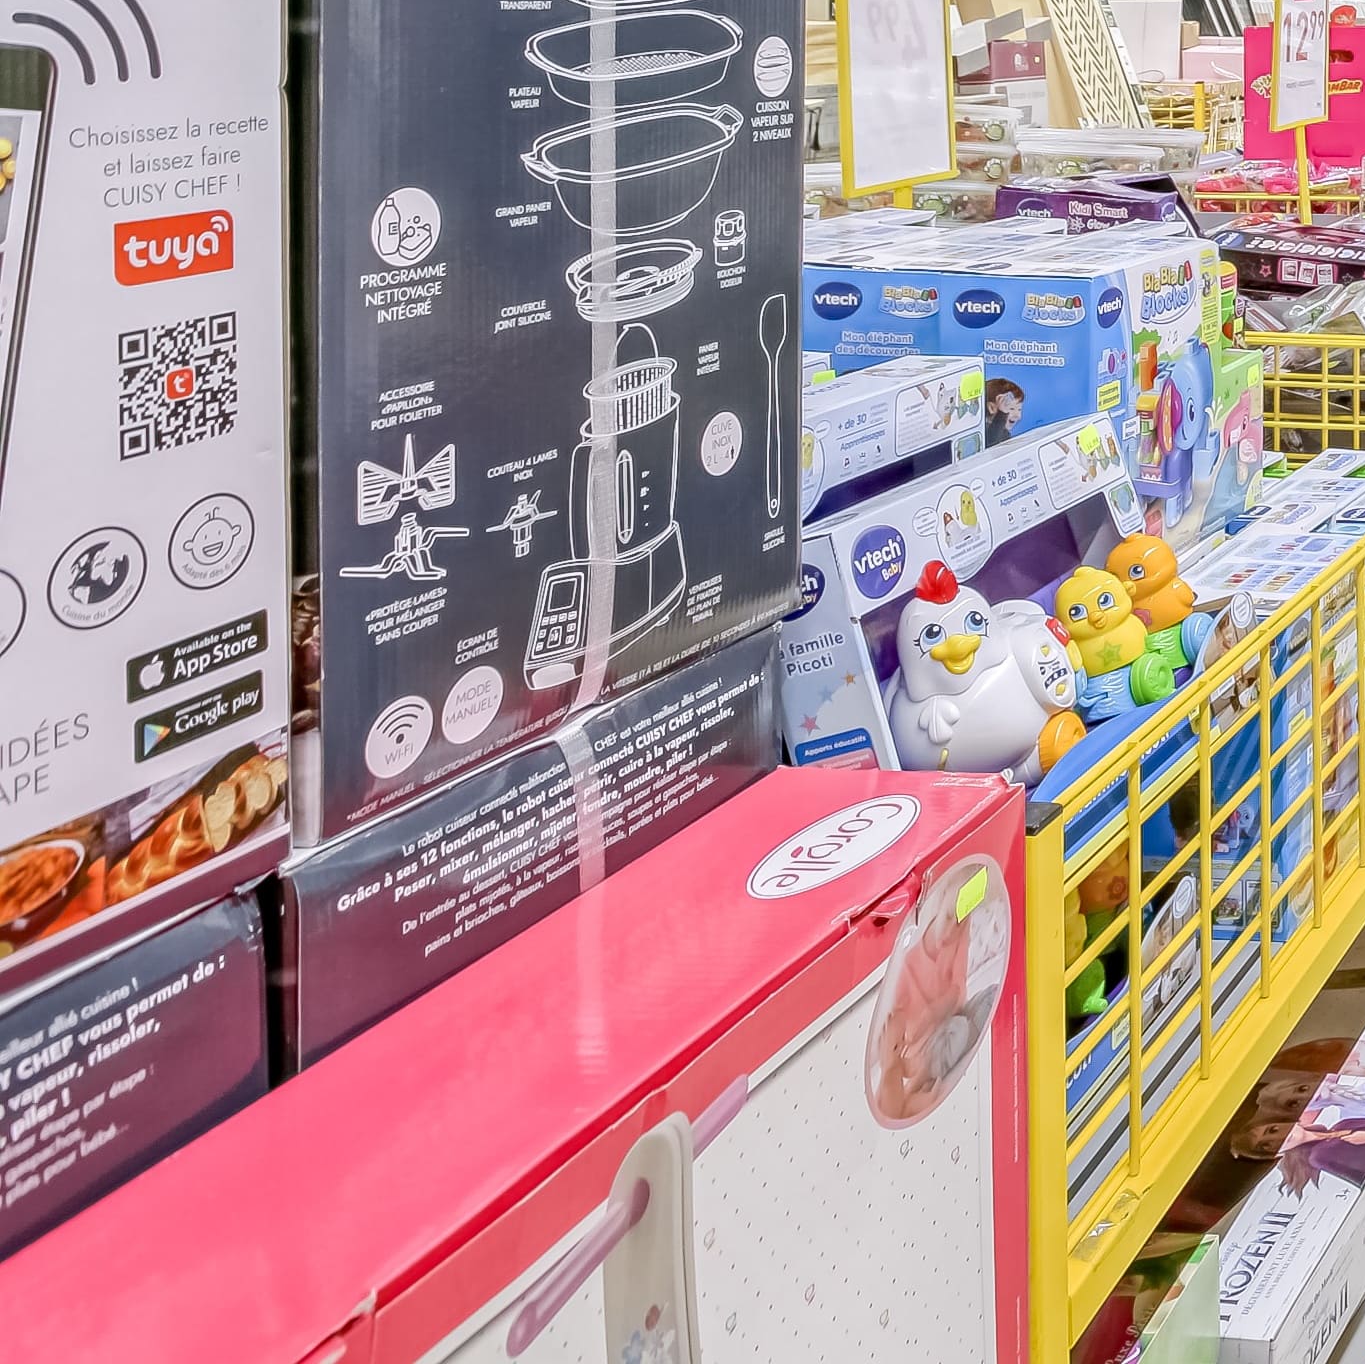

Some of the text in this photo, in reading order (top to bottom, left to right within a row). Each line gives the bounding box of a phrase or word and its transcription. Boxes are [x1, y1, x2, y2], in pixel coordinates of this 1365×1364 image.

[500, 0, 552, 10] TRANSPARENT
[508, 86, 541, 97] PLATEAU
[511, 98, 540, 109] VAPEUR
[756, 100, 789, 113] CUISSON
[68, 115, 269, 149] Choisissez la recette
[751, 113, 794, 127] VAPEUR SUR
[752, 127, 792, 142] 2 NIVEAUX
[103, 146, 242, 177] et laissez faire
[103, 174, 228, 208] CUISY CHEF
[1069, 201, 1129, 219] Kidi Smart
[122, 229, 219, 270] tuya
[360, 262, 447, 289] PROGRAMME
[365, 281, 442, 307] NETTOYAGE
[814, 292, 860, 308] vtech
[1141, 288, 1190, 323] Blocks
[377, 298, 432, 324] INTÉGRÉ
[955, 299, 1001, 316] vtech
[1097, 297, 1122, 317] vtech
[842, 331, 913, 345] Mon éléphant
[835, 344, 920, 357] des découvertes
[378, 380, 436, 403] ACCESSOIRE
[371, 405, 443, 431] POUR FOUETTER
[854, 538, 902, 574] vtech
[881, 562, 902, 583] Baby
[173, 633, 258, 681] App Store
[788, 633, 844, 660] famille
[786, 655, 833, 677] Picoti
[455, 680, 492, 706] MODE
[174, 688, 260, 735] Google play
[761, 803, 903, 888] Corolle
